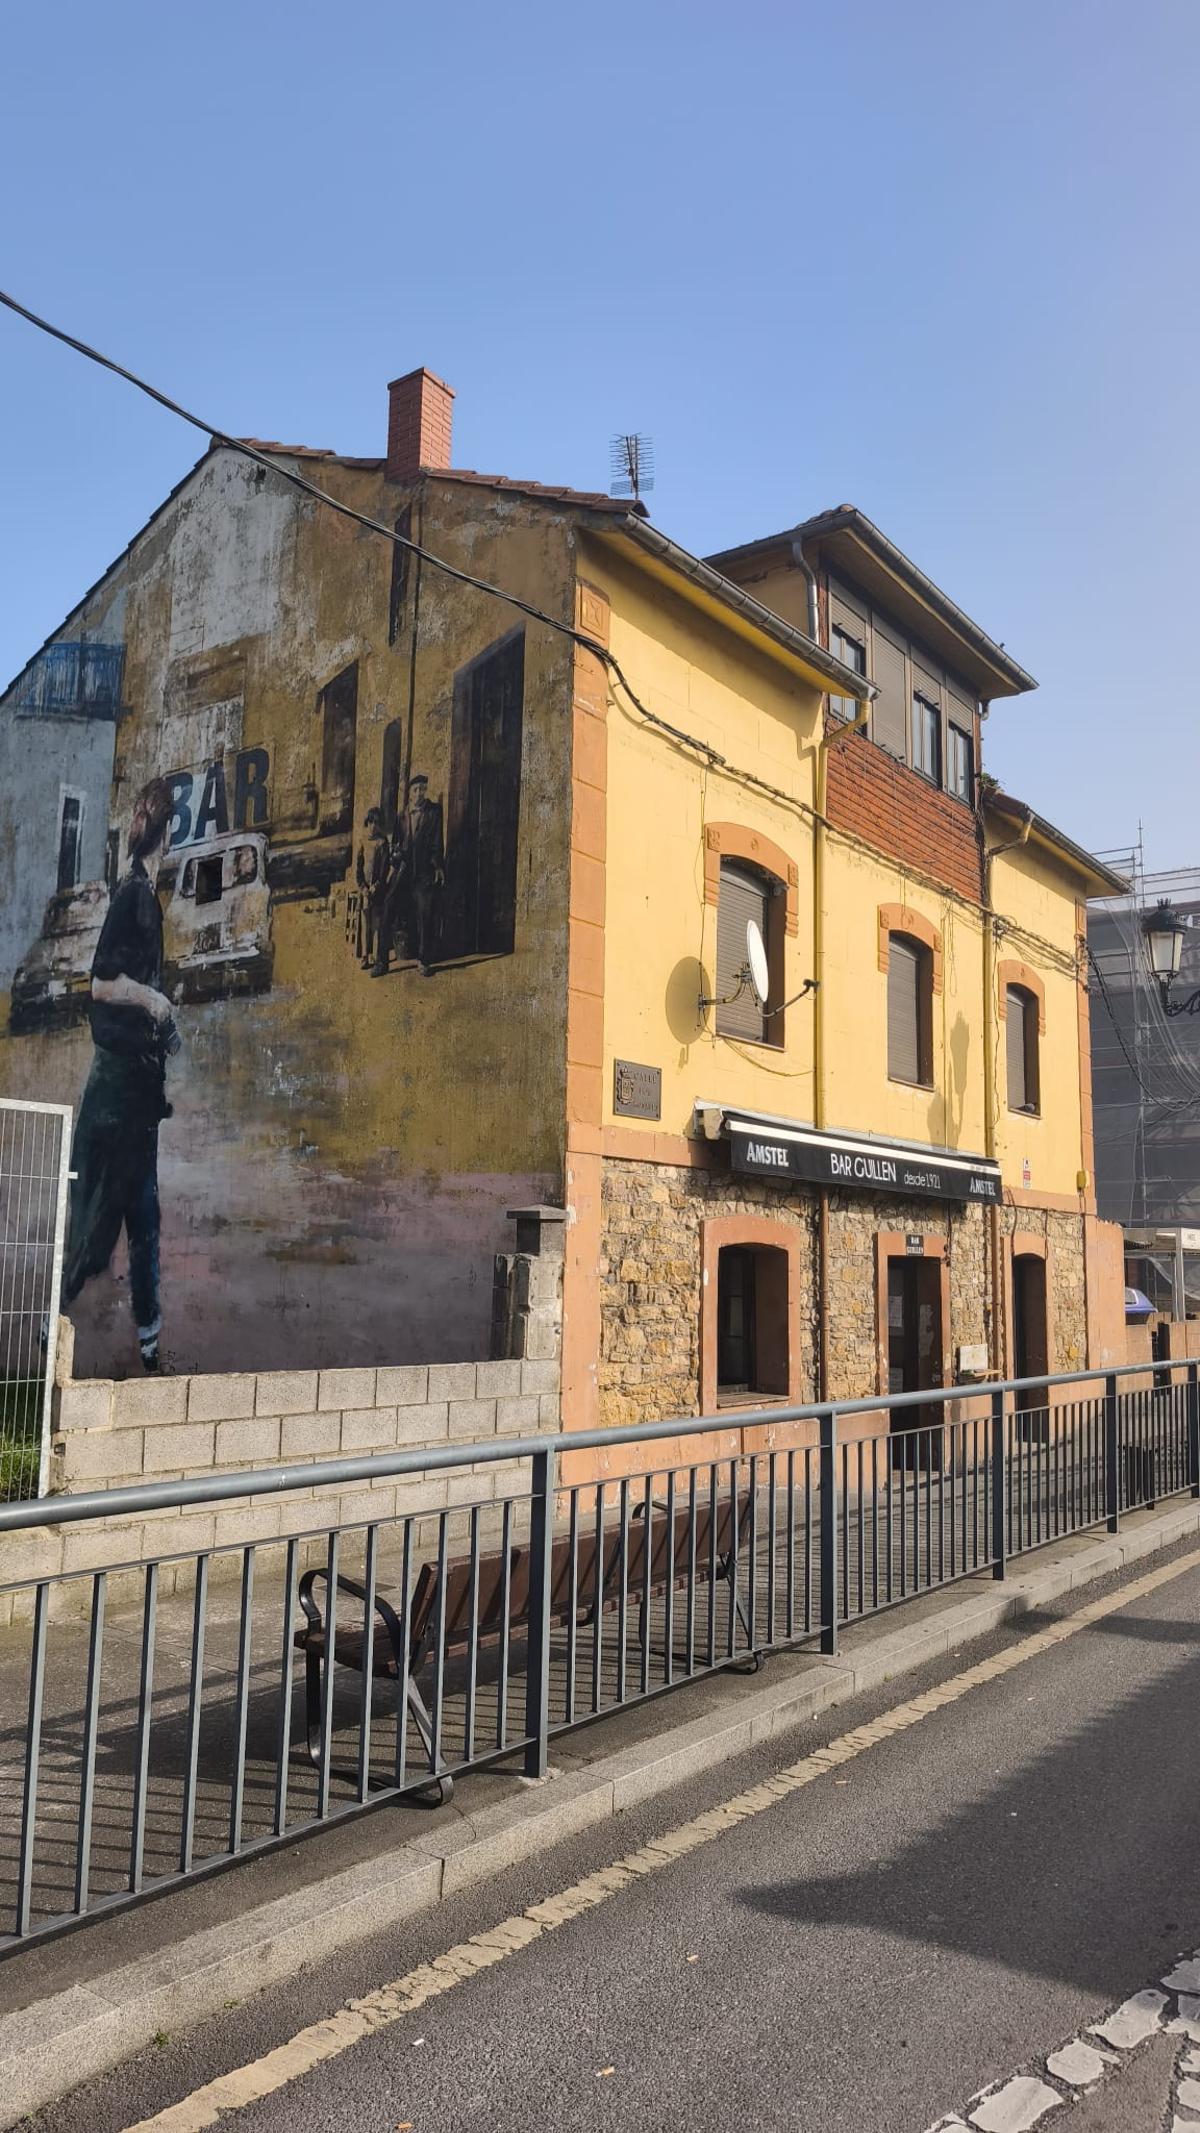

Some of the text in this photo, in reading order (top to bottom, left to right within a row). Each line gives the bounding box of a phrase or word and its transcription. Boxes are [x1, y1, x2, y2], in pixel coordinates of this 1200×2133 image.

[165, 748, 270, 845] BAR
[830, 1153, 852, 1177] BAR
[904, 1170, 926, 1187] desde
